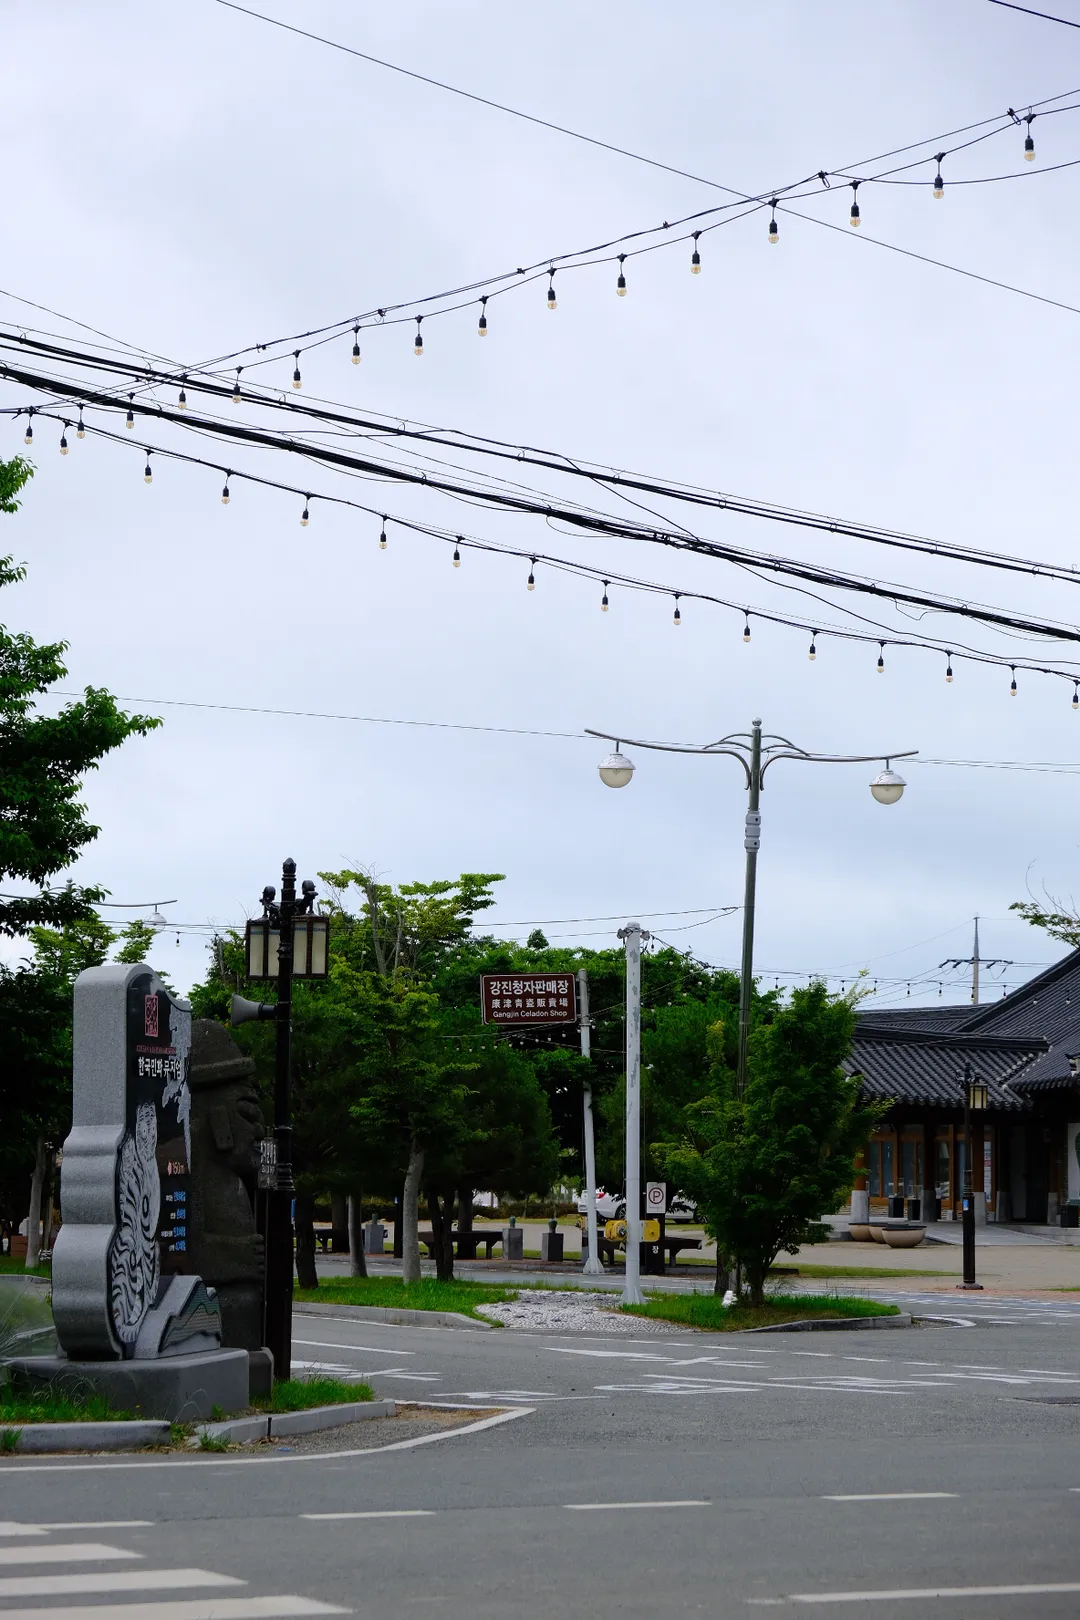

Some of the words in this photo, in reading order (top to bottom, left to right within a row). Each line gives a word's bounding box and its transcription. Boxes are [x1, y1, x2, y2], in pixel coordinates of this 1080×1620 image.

[489, 980, 569, 995] 강진청자판매장
[492, 1011, 519, 1019] Gangjin
[550, 1009, 568, 1017] Shop
